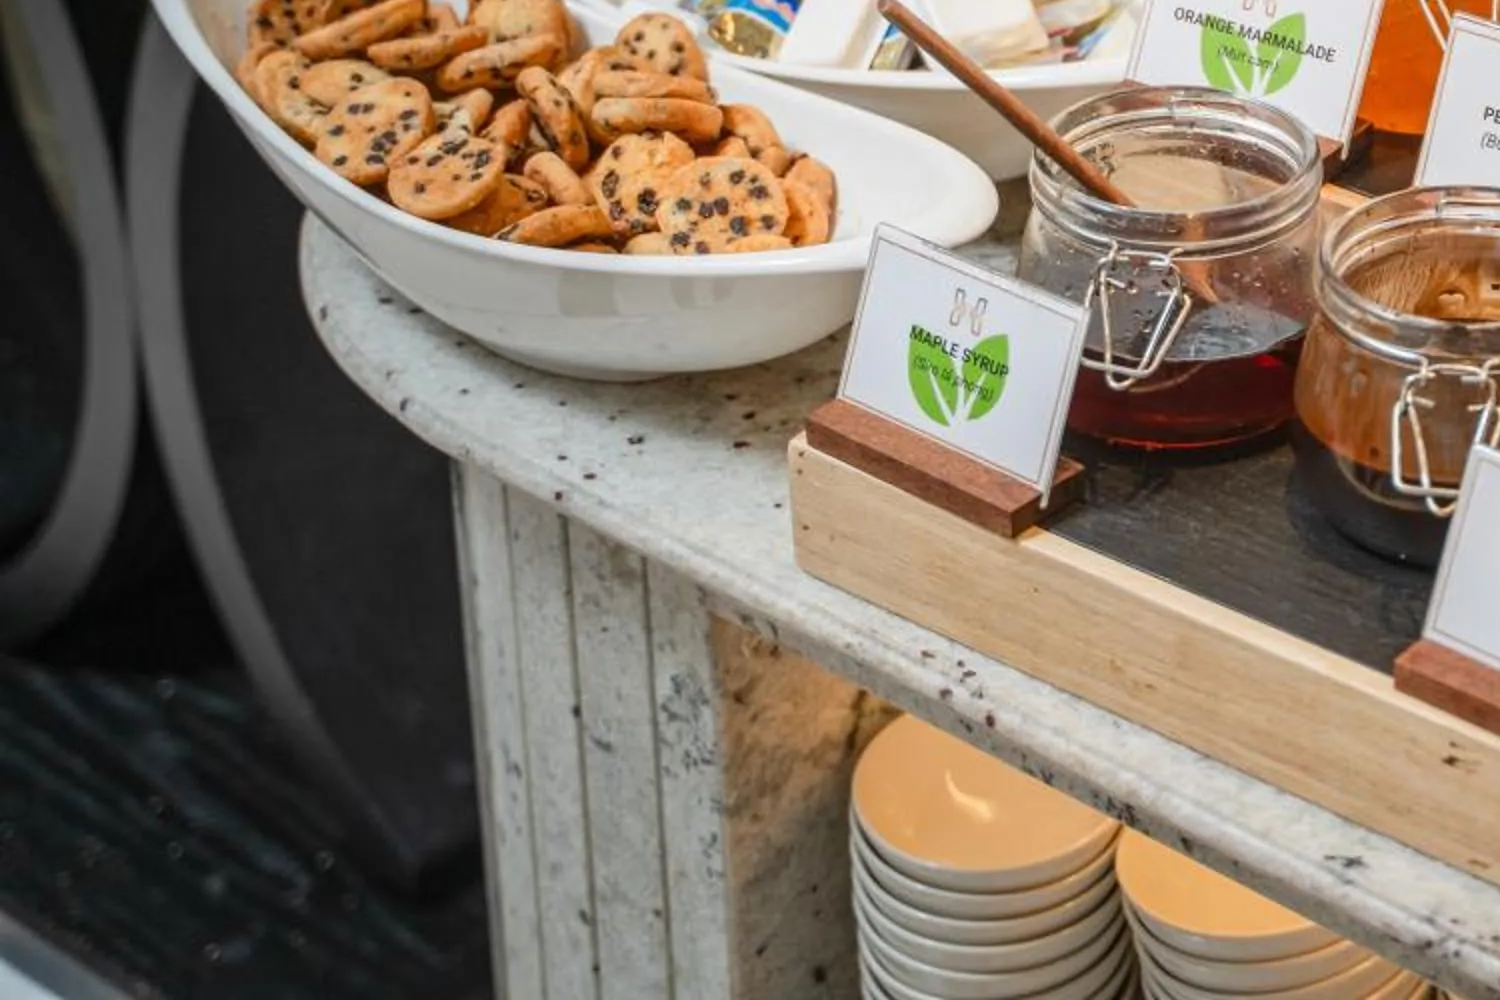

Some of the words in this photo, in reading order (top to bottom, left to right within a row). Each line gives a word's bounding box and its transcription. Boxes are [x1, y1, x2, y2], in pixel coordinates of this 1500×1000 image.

[1173, 6, 1234, 36] ORANGE
[1237, 23, 1337, 63] MARMALADE
[909, 324, 960, 359] MAPLE
[962, 347, 1009, 377] SYRUP
